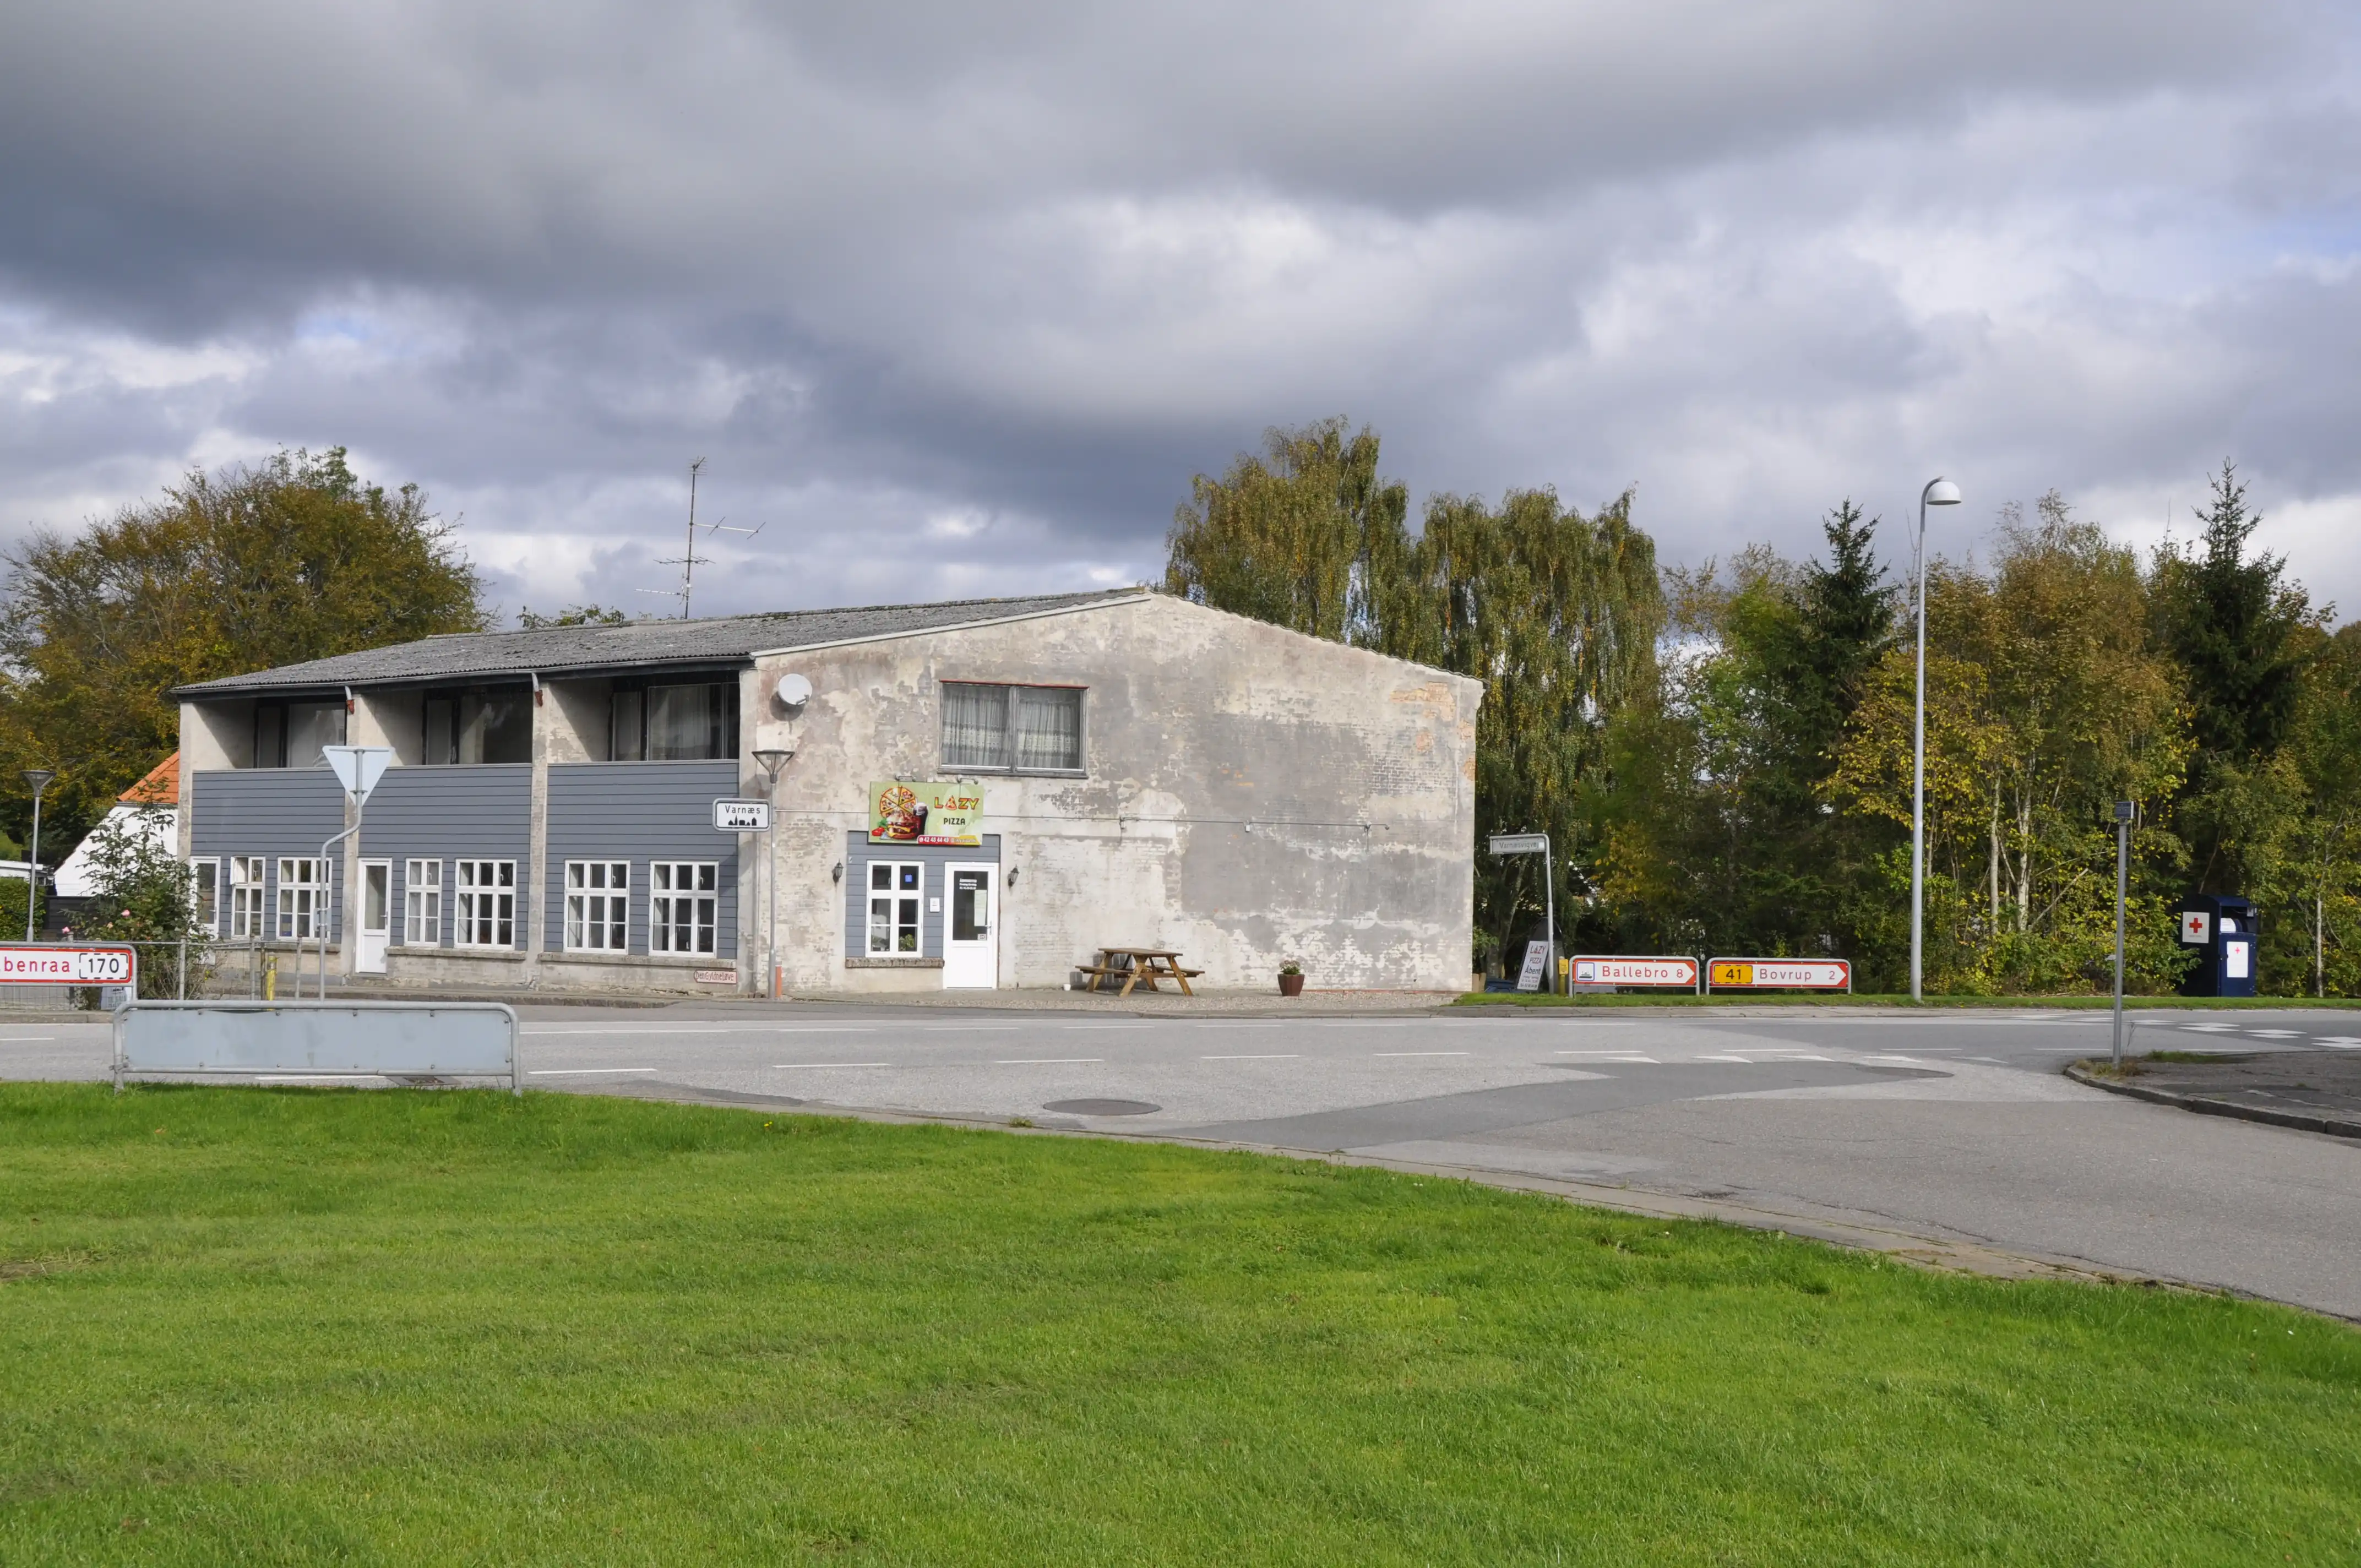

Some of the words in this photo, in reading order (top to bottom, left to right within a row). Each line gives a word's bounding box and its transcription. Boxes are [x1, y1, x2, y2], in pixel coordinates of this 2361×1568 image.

[725, 804, 760, 814] Varnæs
[1530, 945, 1546, 954] LAZY
[0, 956, 70, 972] benraa
[88, 958, 119, 973] 170
[1602, 966, 1668, 978] Ballebro
[1676, 968, 1683, 978] 8
[1726, 969, 1741, 979] 41
[1759, 968, 1811, 982] Bovrup
[1829, 971, 1835, 980] 2
